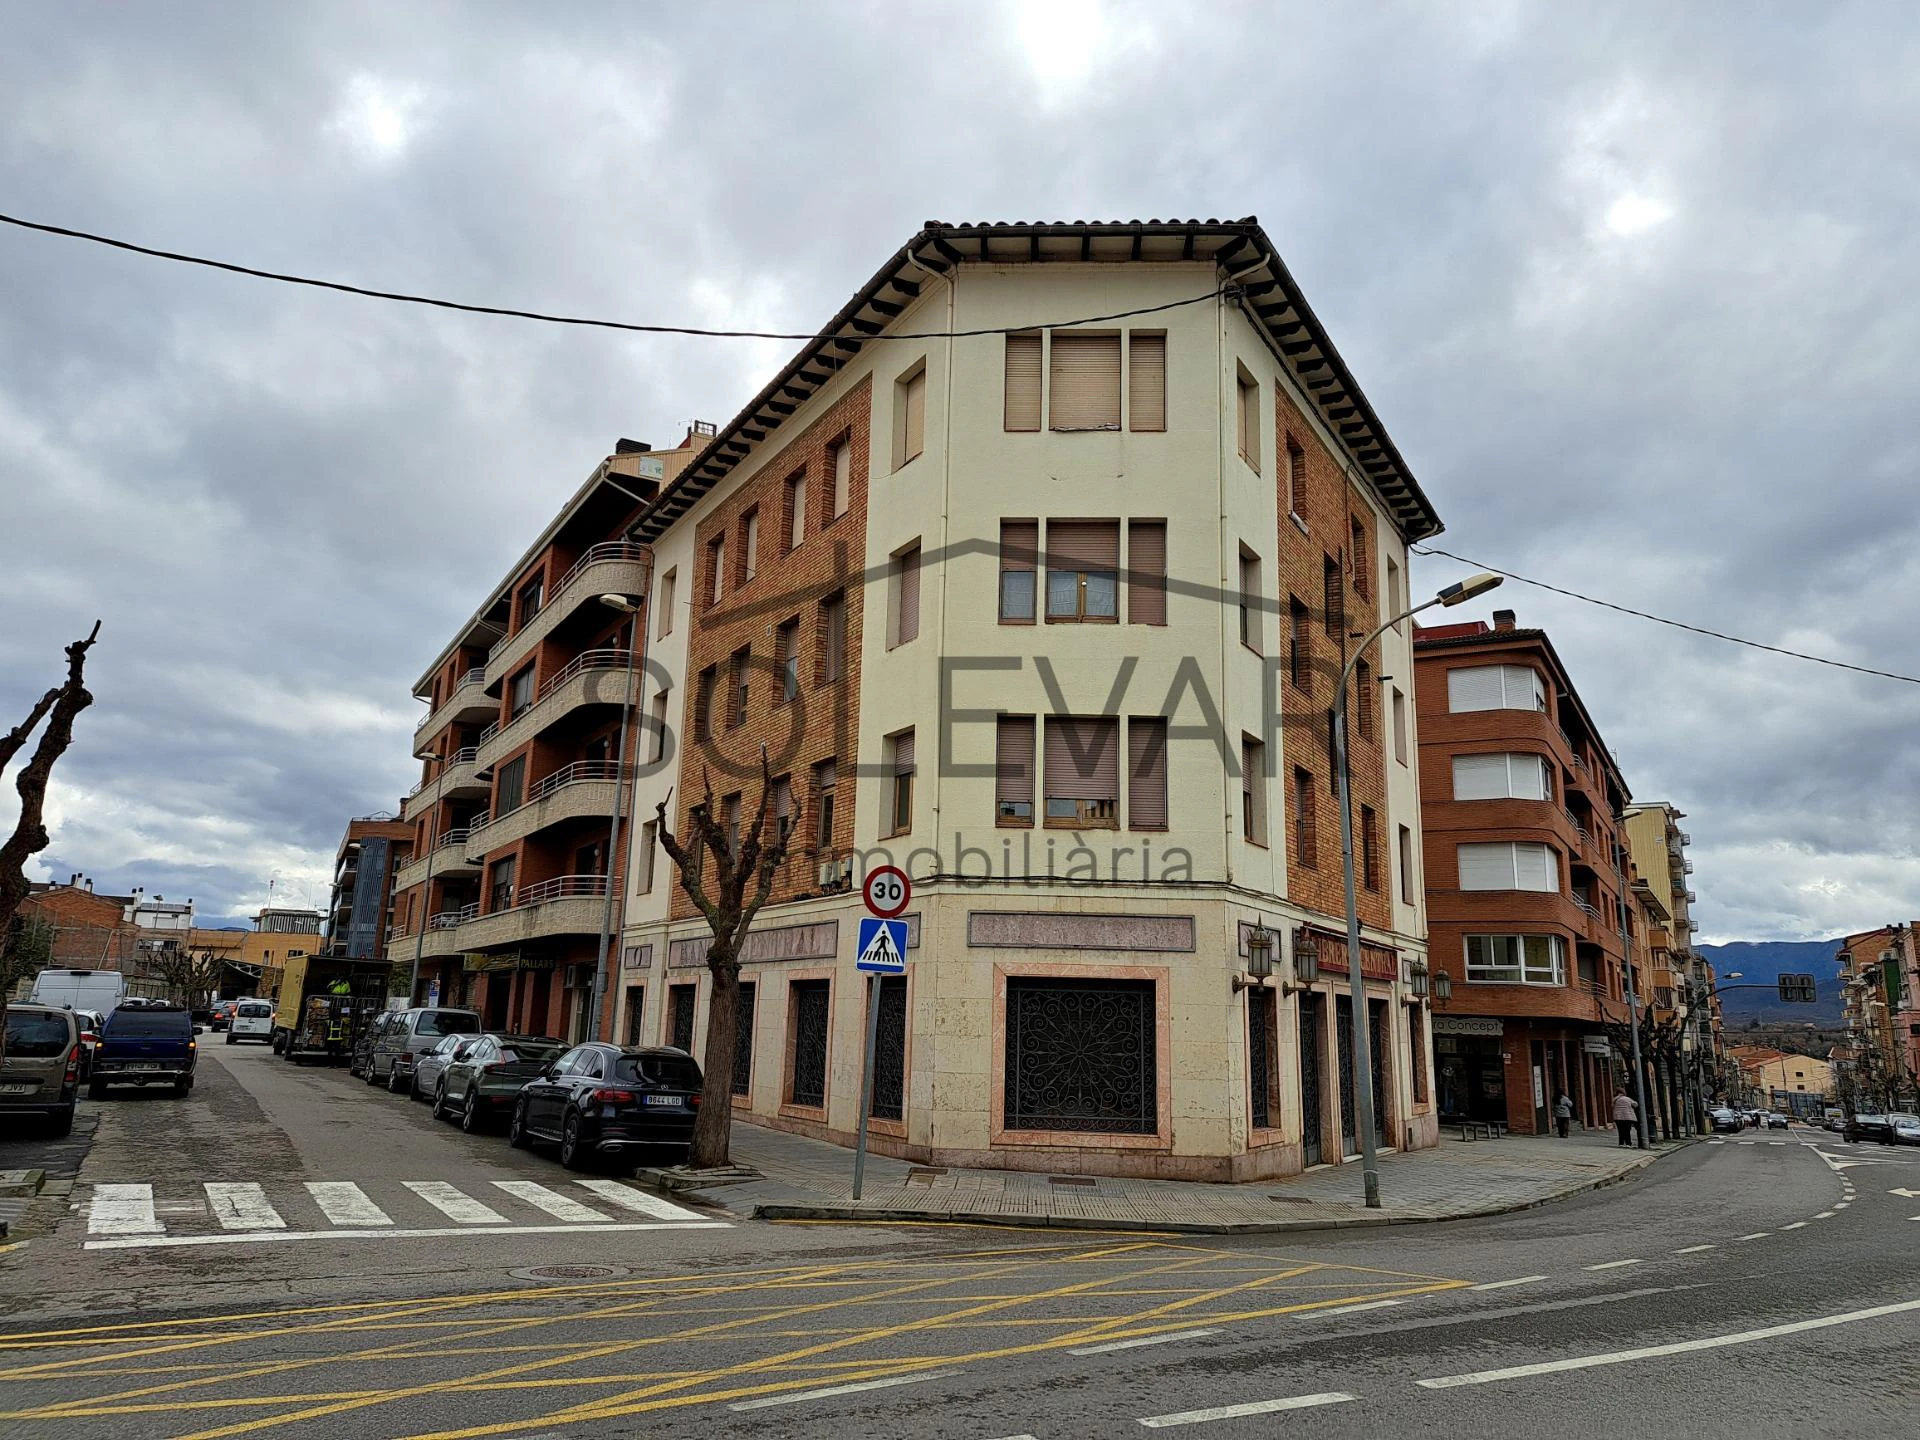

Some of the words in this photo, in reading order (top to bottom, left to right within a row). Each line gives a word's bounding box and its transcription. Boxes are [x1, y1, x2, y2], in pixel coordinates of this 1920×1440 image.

[874, 881, 902, 901] 30
[1433, 1021, 1445, 1030] ra
[1447, 1019, 1499, 1032] Concept
